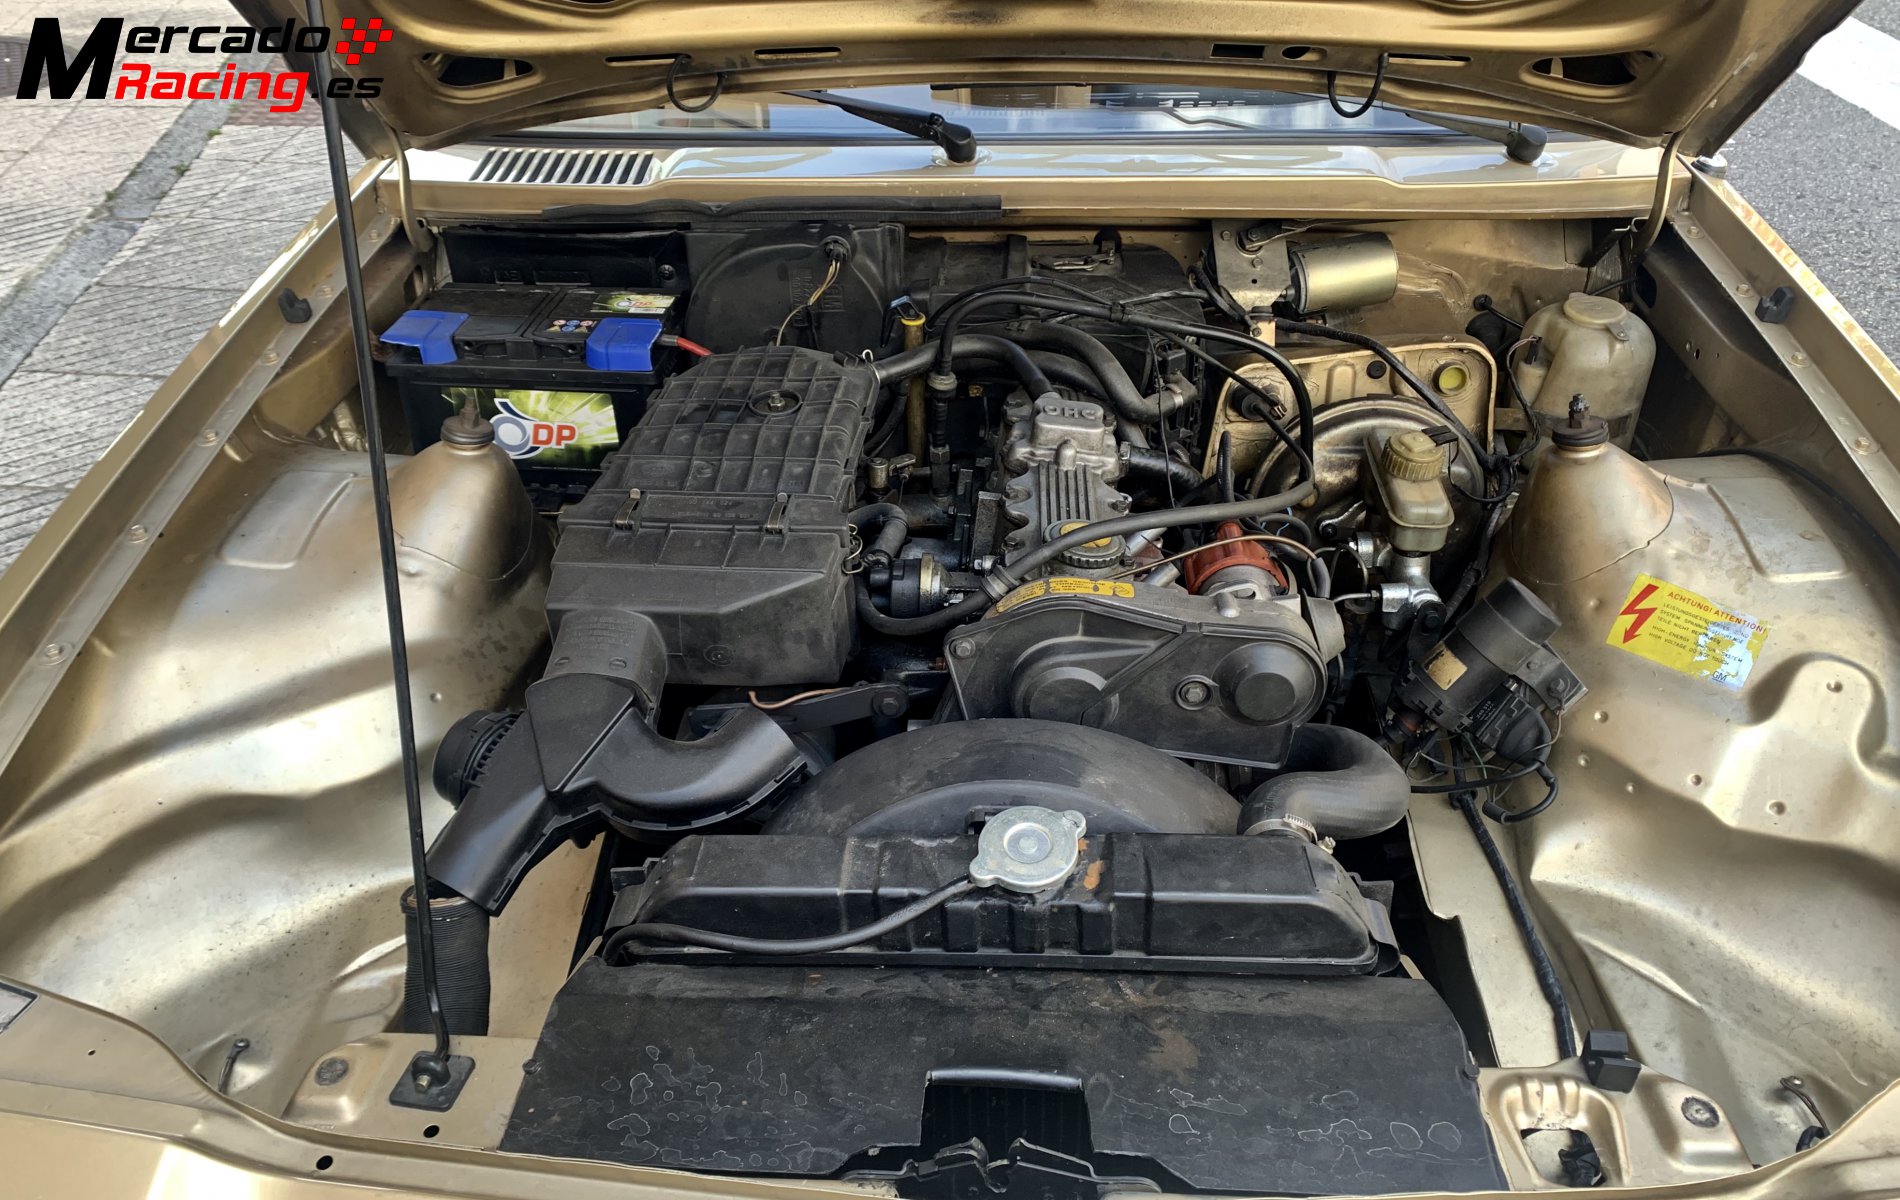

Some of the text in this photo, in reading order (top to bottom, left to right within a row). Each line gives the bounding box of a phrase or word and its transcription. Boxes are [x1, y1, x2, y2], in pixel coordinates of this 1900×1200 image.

[1043, 405, 1096, 420] OHC
[532, 422, 577, 447] DP
[1659, 609, 1680, 620] SYSTEM
[1667, 592, 1767, 634] ACHTUNG! ATTENTION!
[1673, 623, 1689, 632] NICHT
[1648, 632, 1662, 640] HIGH
[1663, 638, 1687, 650] VOLTAGE
[1712, 670, 1727, 682] GM
